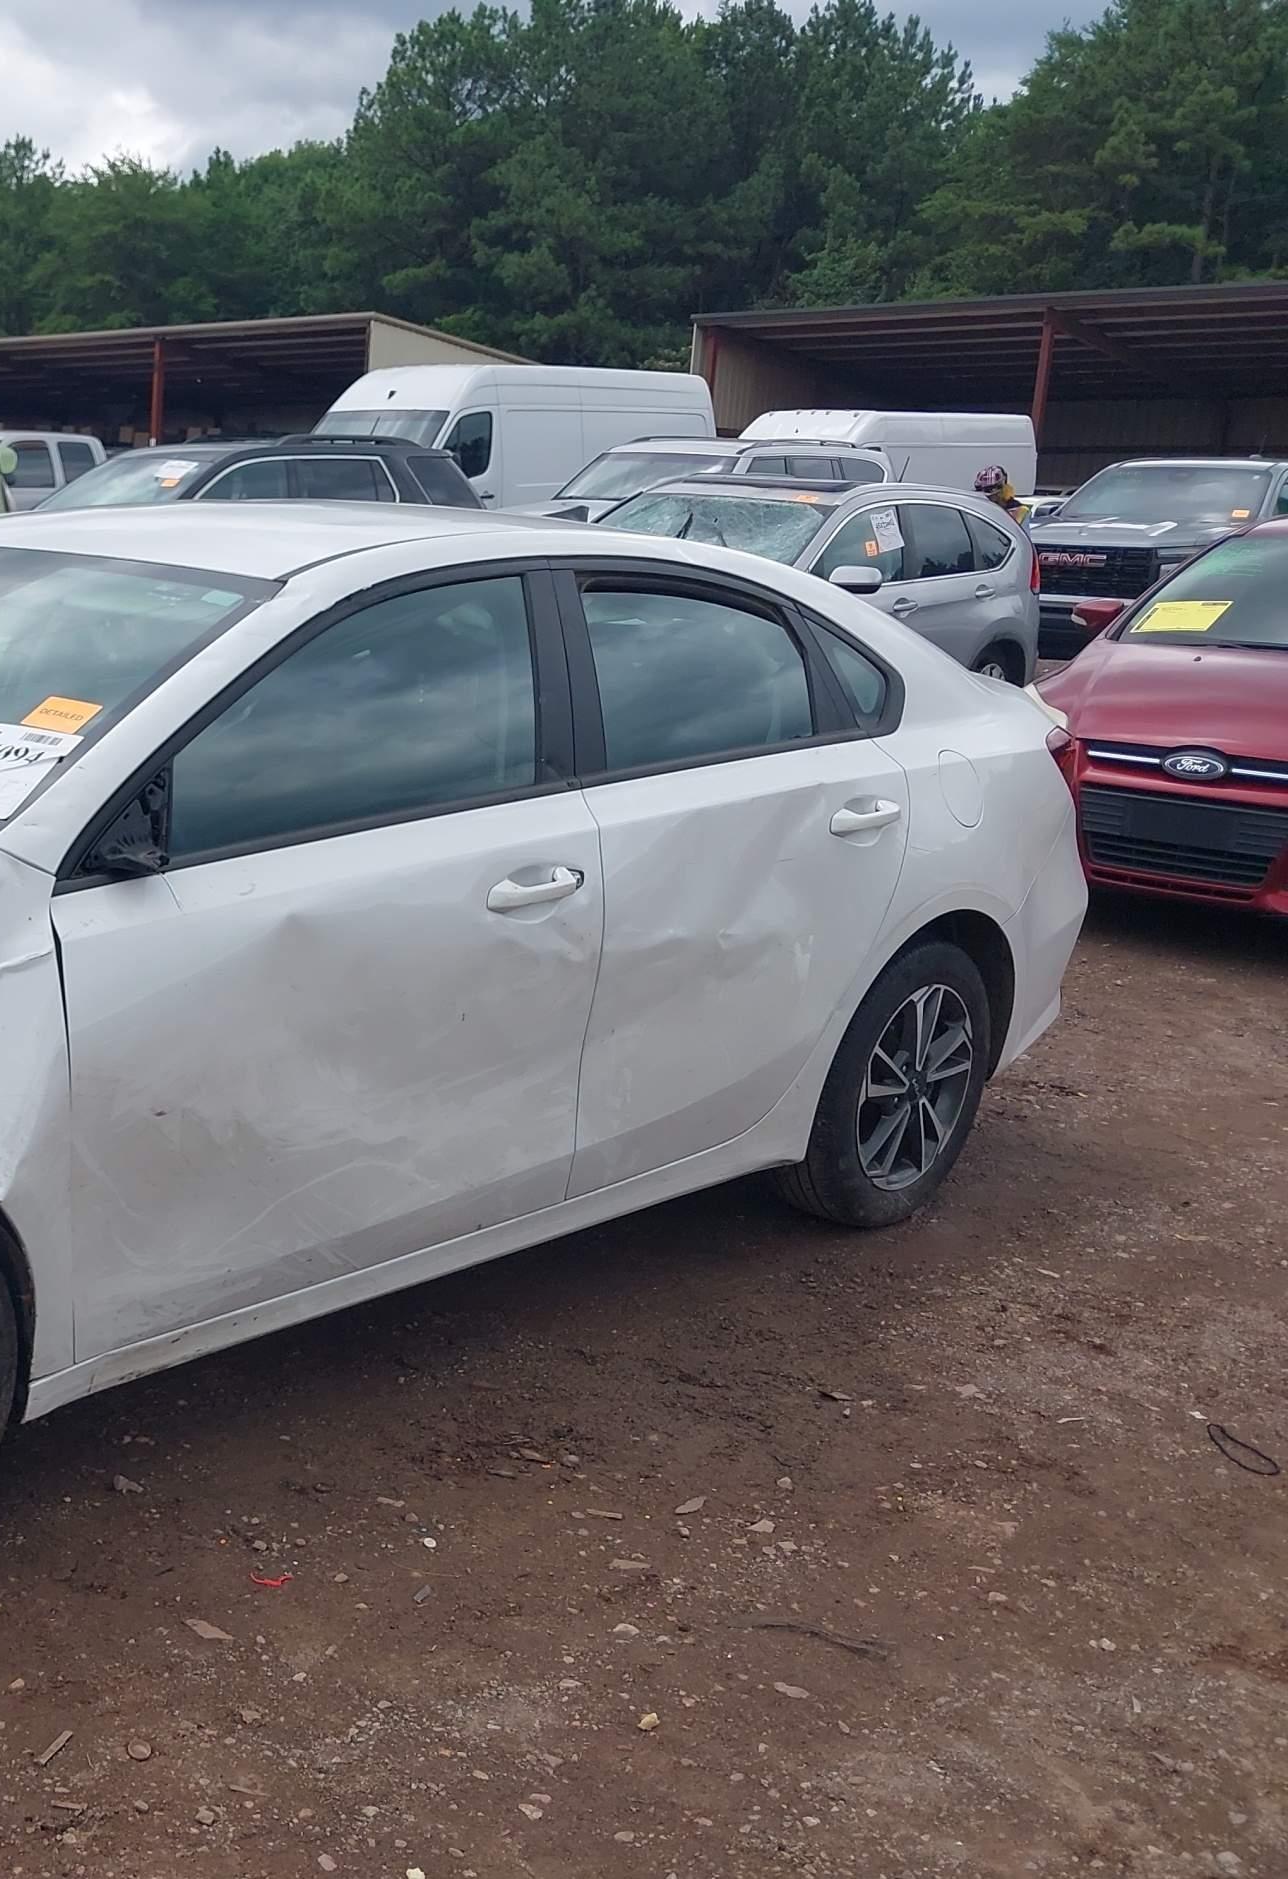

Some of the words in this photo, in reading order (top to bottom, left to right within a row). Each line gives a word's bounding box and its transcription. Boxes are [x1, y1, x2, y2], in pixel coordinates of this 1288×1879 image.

[1038, 552, 1107, 568] GMC
[39, 708, 85, 722] DETAILED
[1176, 758, 1210, 774] Ford
